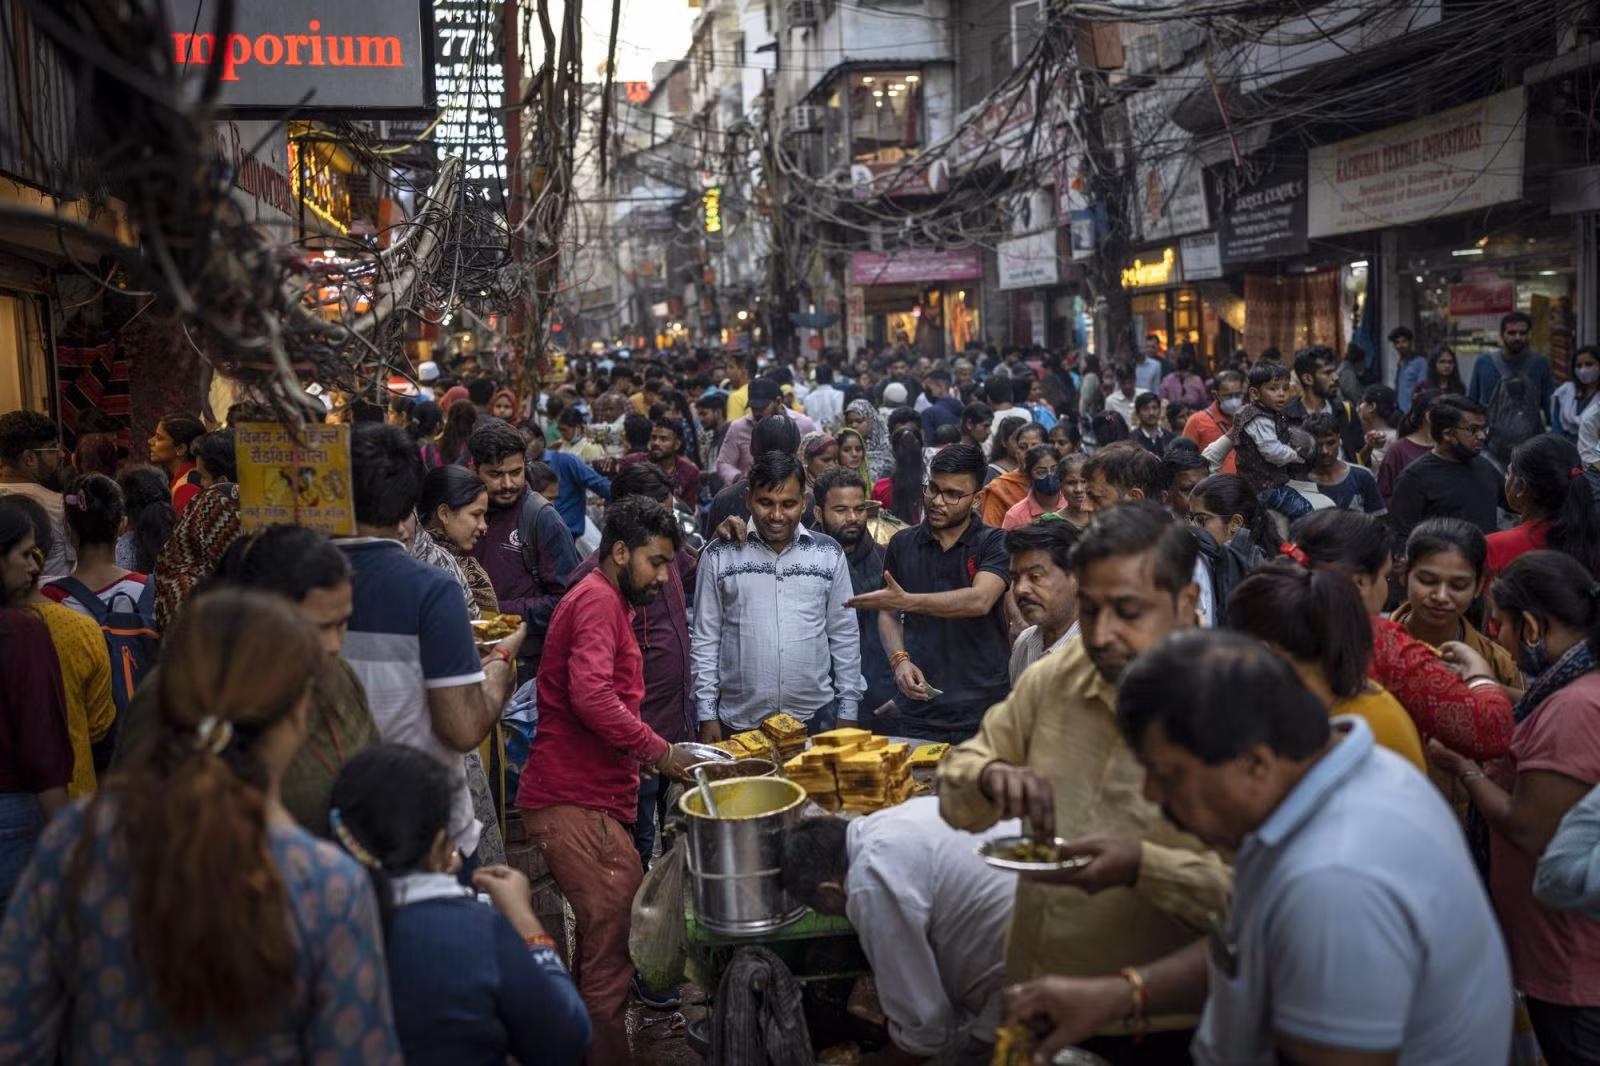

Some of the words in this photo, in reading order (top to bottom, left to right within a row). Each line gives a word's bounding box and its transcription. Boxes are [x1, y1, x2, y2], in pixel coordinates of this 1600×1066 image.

[169, 19, 405, 81] mporium
[1382, 138, 1420, 173] TEXTILE
[1421, 121, 1483, 163] INDUSTRIES
